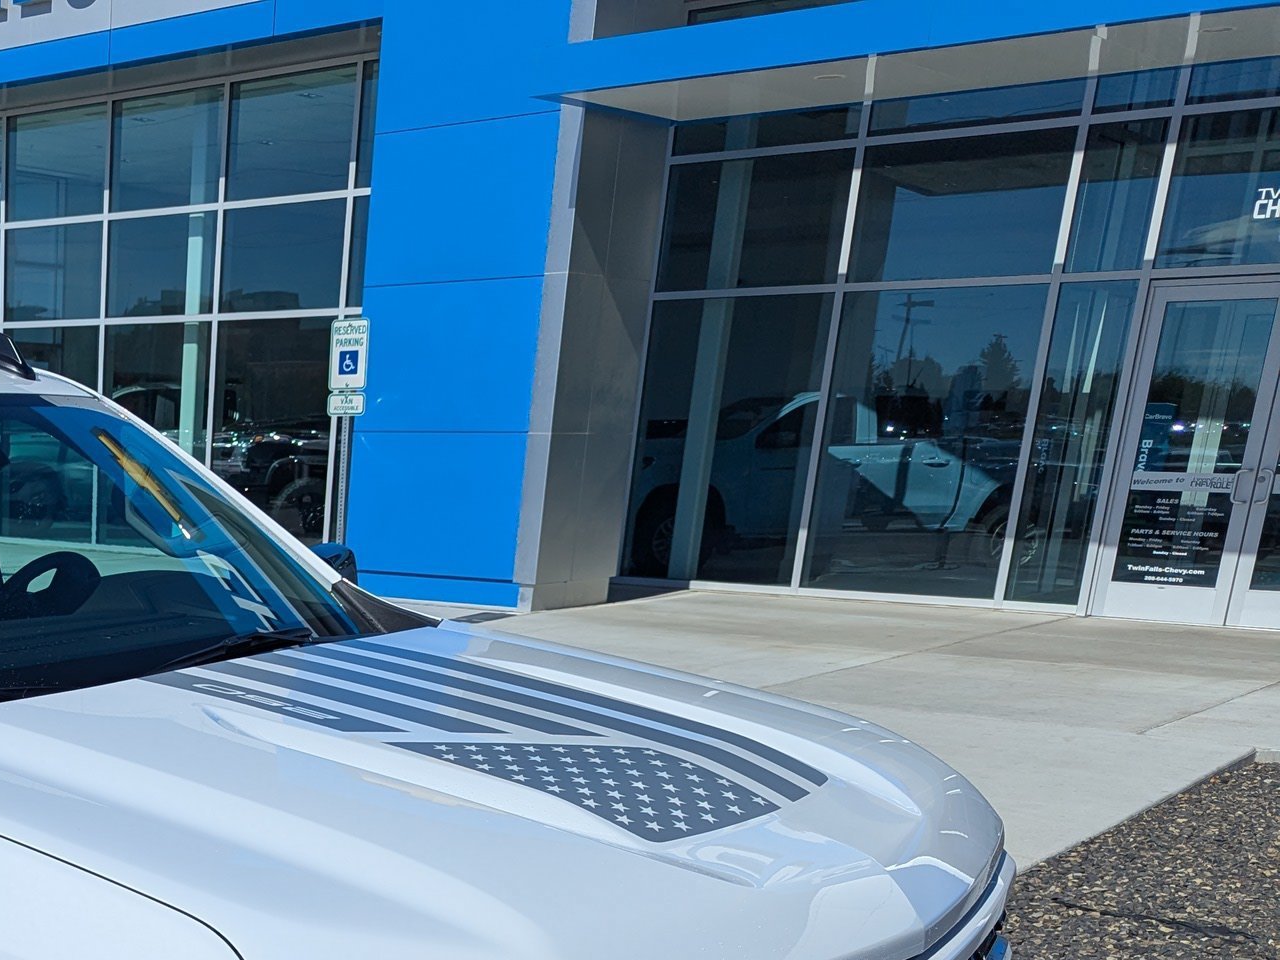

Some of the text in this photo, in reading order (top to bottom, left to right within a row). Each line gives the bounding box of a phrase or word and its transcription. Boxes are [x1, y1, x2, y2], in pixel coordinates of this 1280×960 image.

[334, 324, 367, 335] RESERVED
[335, 337, 364, 348] PARKING
[1132, 478, 1173, 486] Welcome
[1161, 529, 1192, 537] SERVICE
[1127, 564, 1205, 576] TwinFalls-Chevy.com
